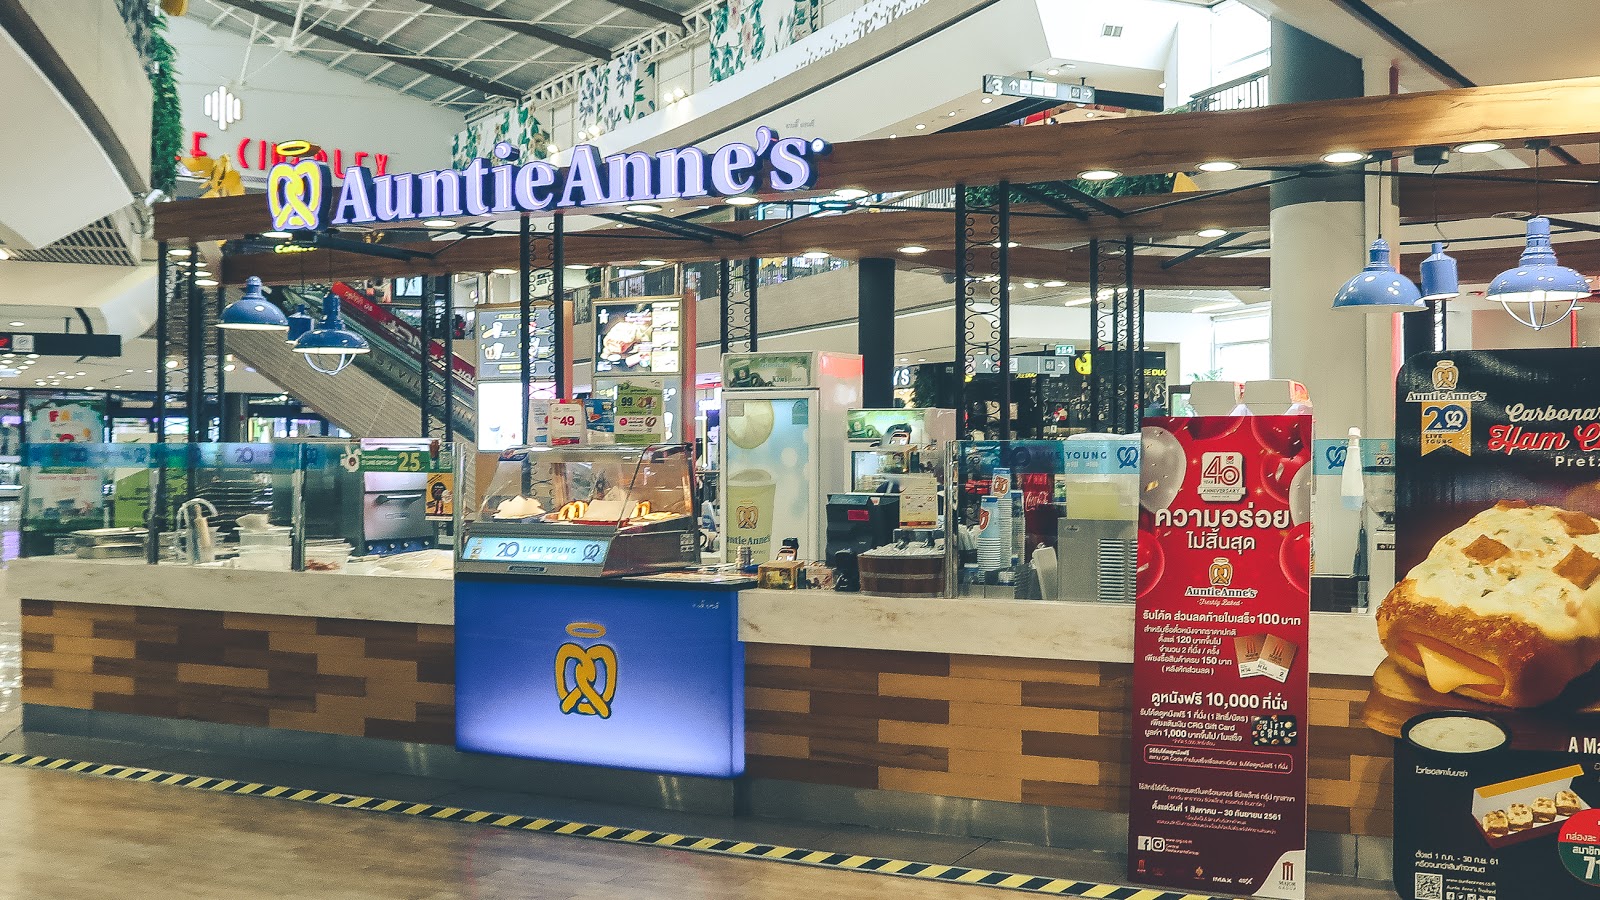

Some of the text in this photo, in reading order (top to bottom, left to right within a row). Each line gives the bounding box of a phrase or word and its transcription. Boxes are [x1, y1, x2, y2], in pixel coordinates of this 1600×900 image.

[992, 79, 1003, 96] 3
[1406, 390, 1486, 402] AuntieAnne's
[560, 416, 576, 426] 49
[1423, 404, 1468, 431] 20
[1488, 424, 1570, 455] Ham
[398, 452, 420, 471] 25
[1066, 451, 1108, 460] YOUNG
[1556, 456, 1600, 466] Pret
[1203, 456, 1240, 486] 40
[1154, 502, 1290, 528] ความอร่อย
[496, 542, 520, 558] 20
[1186, 529, 1256, 555] ไม่สิ้นสุด
[1186, 586, 1258, 598] AuntieAnne's
[1143, 610, 1172, 620] รับโค้ด
[1257, 613, 1280, 624] 100
[1281, 617, 1300, 626] บาท
[1202, 657, 1217, 665] 150
[1152, 691, 1288, 710] ดูหนังฟรี 10,000 ที่นั่ง
[1164, 729, 1187, 738] 1,000
[1204, 722, 1217, 730] Gift
[1218, 723, 1235, 731] Card
[1568, 736, 1579, 753] A
[1566, 832, 1598, 842] กล่องละ
[1415, 848, 1432, 860] ตั้งแต่
